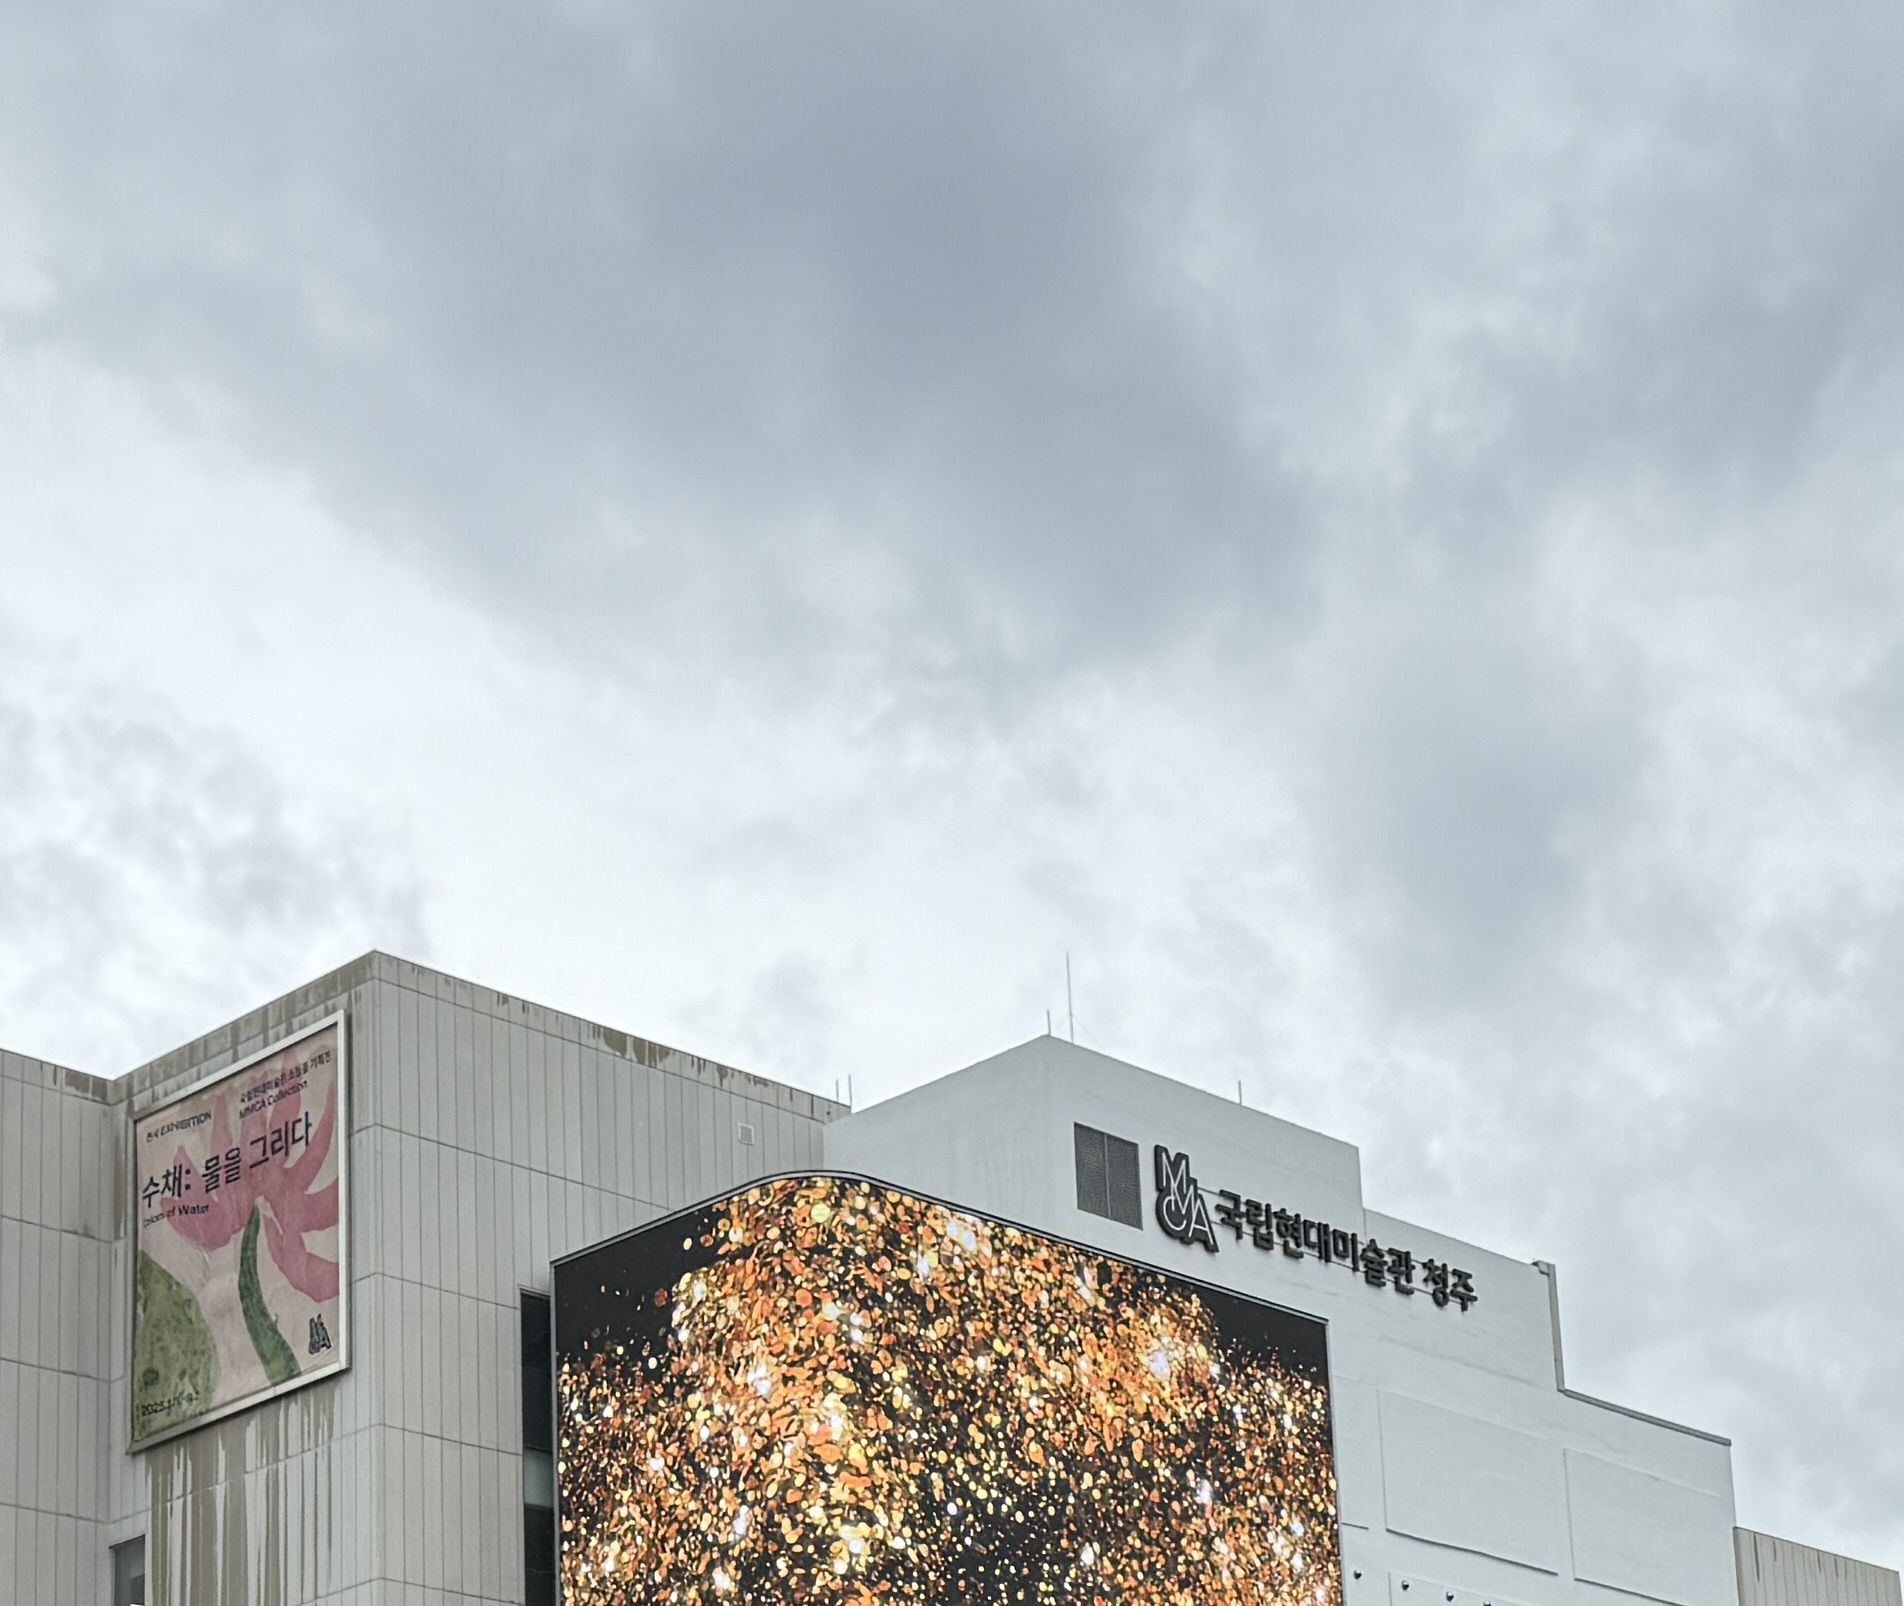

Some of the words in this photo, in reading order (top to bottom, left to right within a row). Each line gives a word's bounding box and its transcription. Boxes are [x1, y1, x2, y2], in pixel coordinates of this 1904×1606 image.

[142, 1163, 192, 1208] 수채:
[202, 1146, 242, 1194] 물을
[249, 1111, 312, 1169] 그리다
[1215, 1188, 1416, 1296] 국립현대미술관
[1422, 1256, 1478, 1312] 청주
